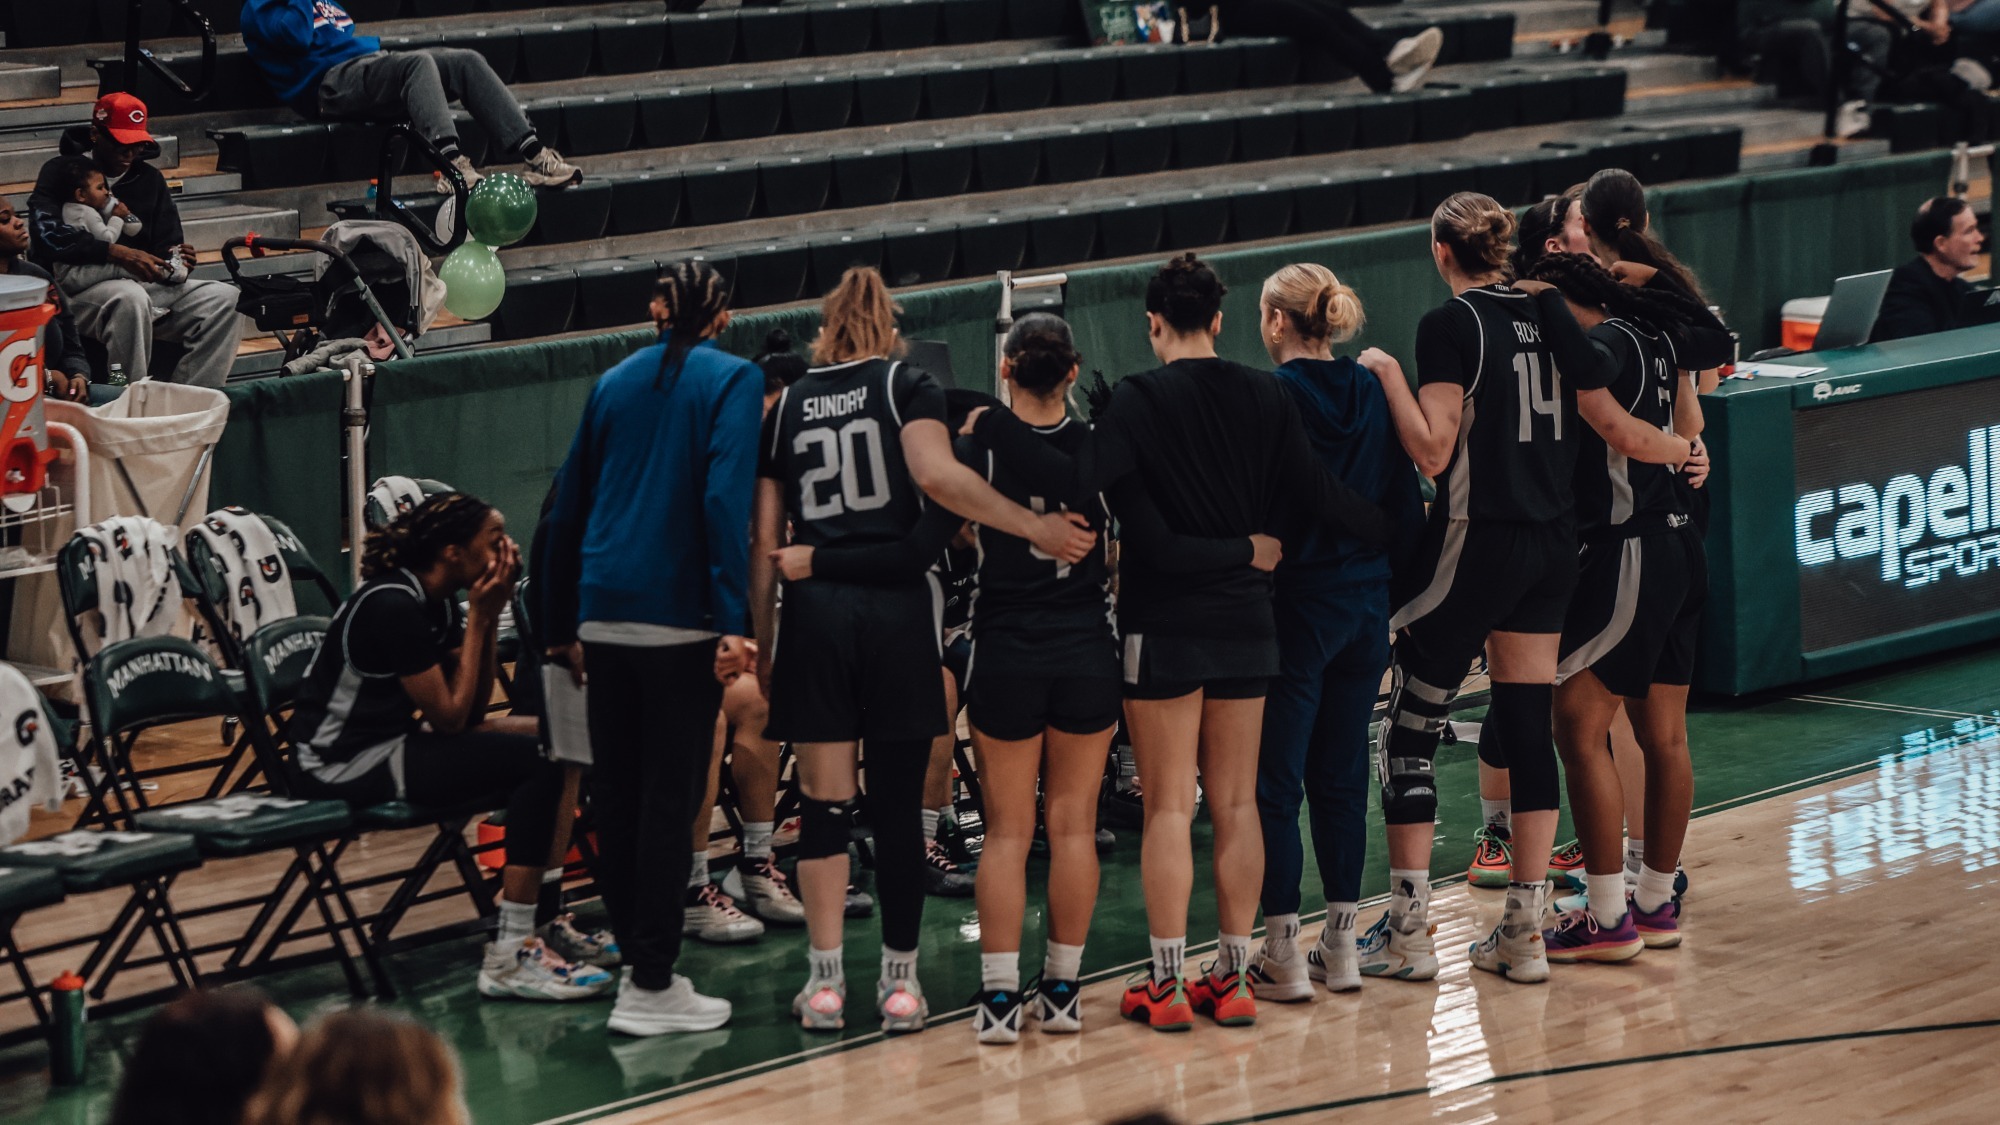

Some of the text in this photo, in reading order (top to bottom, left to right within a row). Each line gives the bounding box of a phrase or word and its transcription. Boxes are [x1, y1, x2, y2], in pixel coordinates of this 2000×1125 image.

[129, 110, 144, 123] C
[1512, 321, 1541, 343] ROY
[0, 338, 38, 402] G
[803, 386, 867, 421] SUNDAY
[1512, 351, 1562, 442] 14
[793, 418, 891, 521] 20
[1904, 534, 2000, 589] SPOR
[106, 652, 213, 699] MANHATTAN
